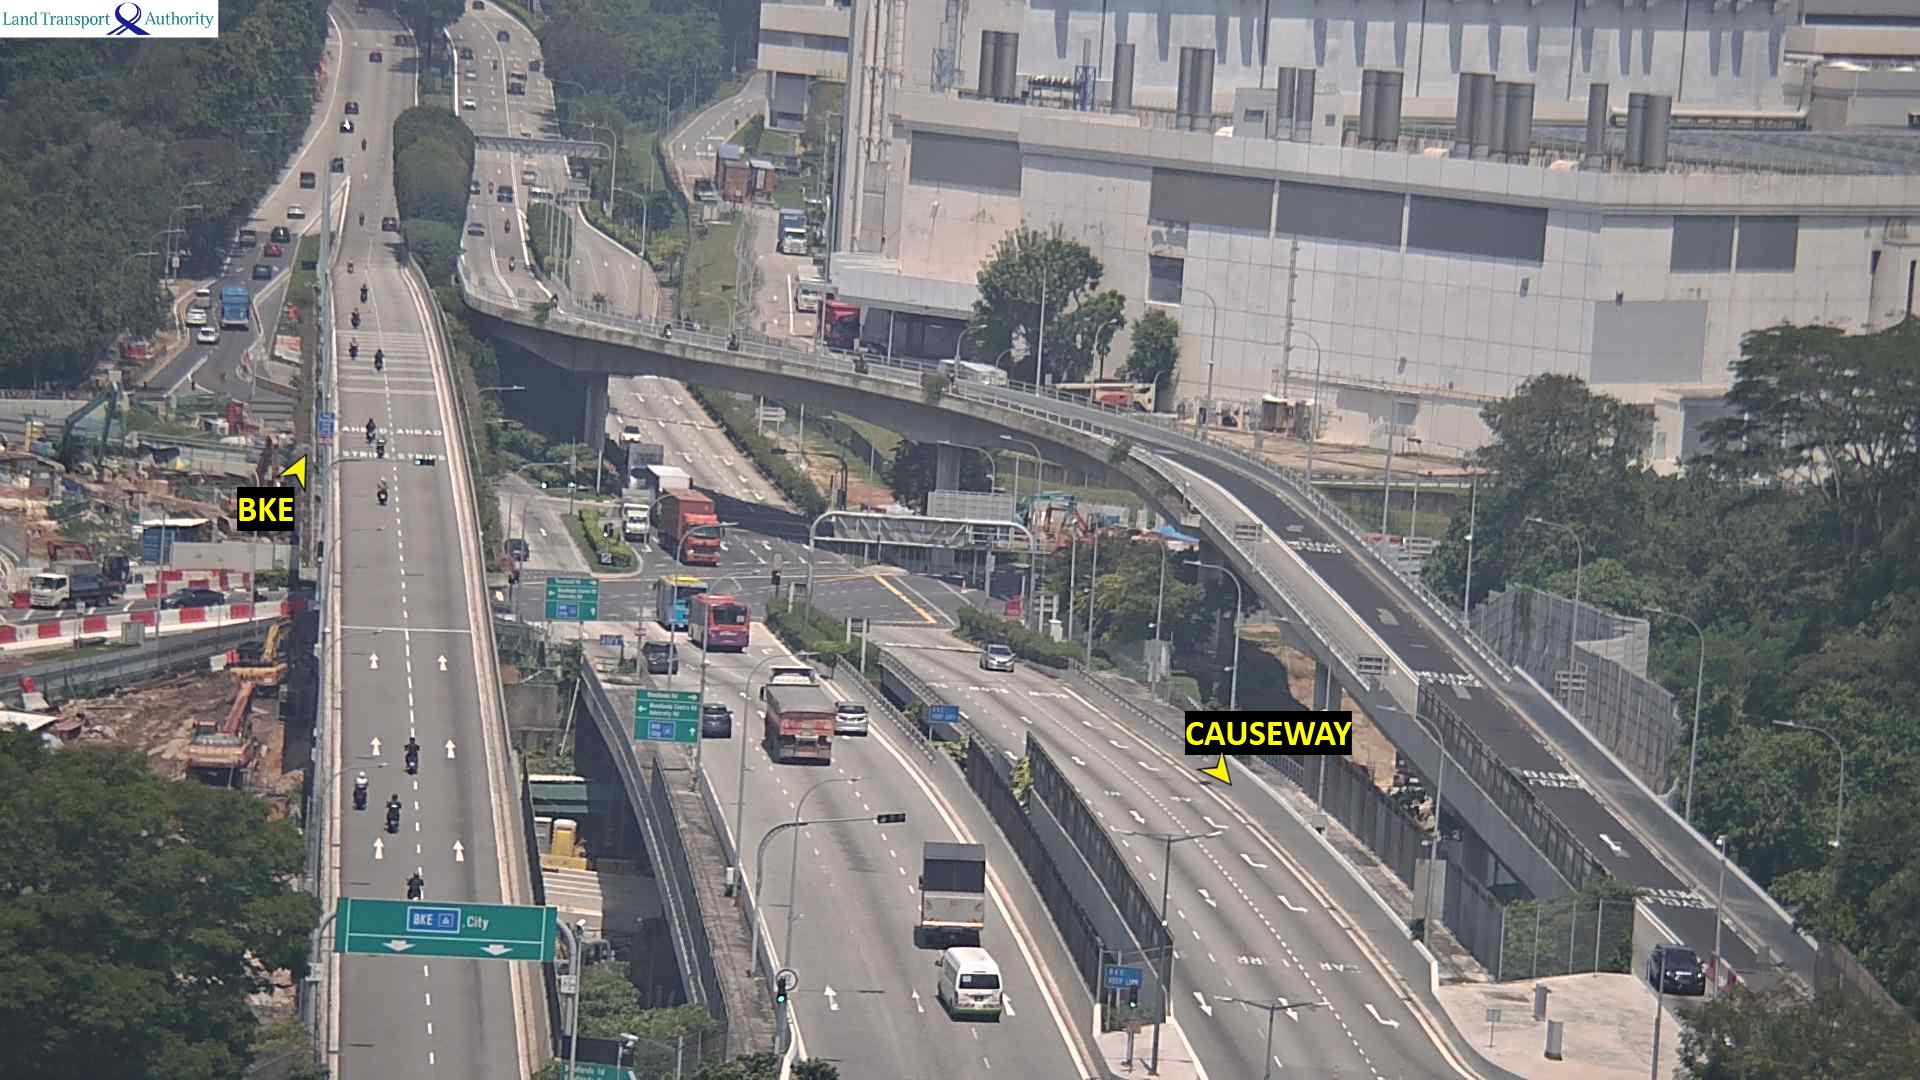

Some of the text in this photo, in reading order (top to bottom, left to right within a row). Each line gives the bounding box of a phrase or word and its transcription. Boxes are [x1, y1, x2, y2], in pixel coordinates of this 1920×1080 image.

[398, 452, 446, 461] STRIPS
[412, 913, 489, 931] BKE City
